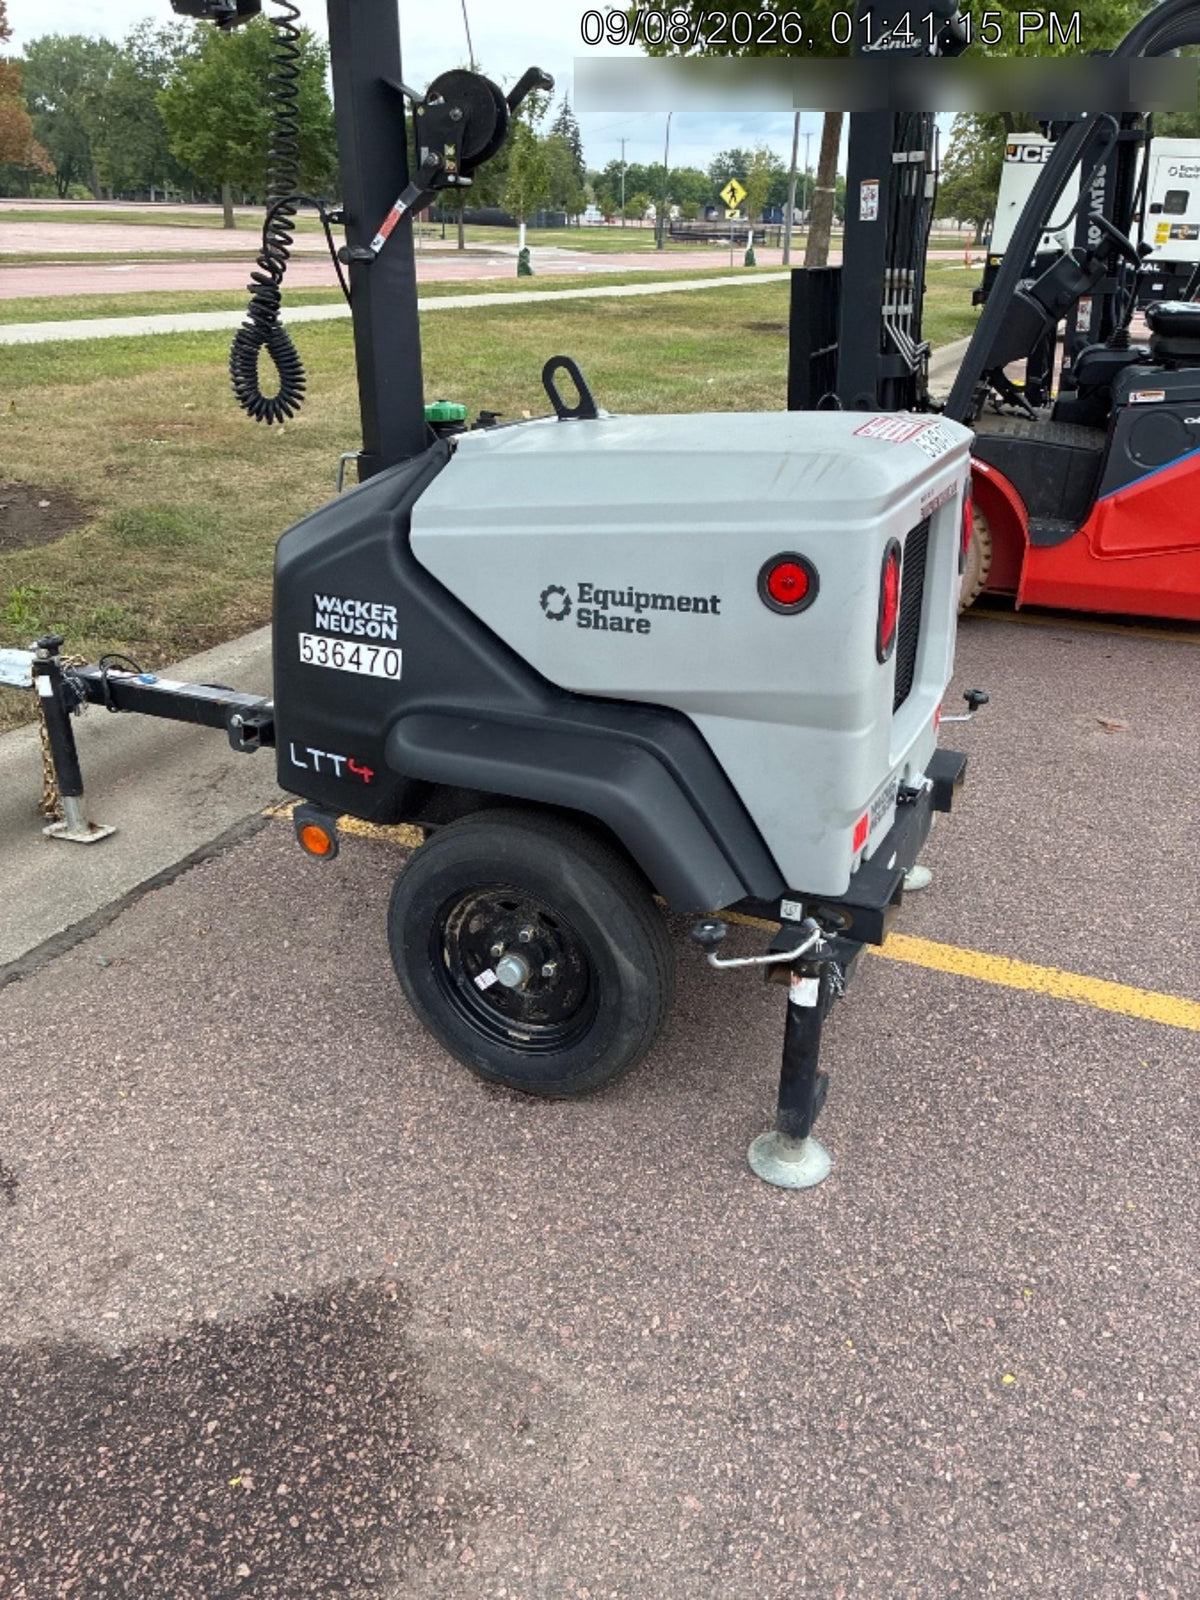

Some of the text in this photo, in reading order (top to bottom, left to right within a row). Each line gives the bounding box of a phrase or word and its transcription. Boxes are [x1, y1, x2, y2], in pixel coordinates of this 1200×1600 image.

[314, 593, 398, 623] WACKER
[577, 582, 722, 616] Equipment
[315, 611, 398, 641] NEUSON
[576, 607, 652, 635] Share
[302, 636, 400, 677] 536470
[289, 742, 374, 784] LTT4
